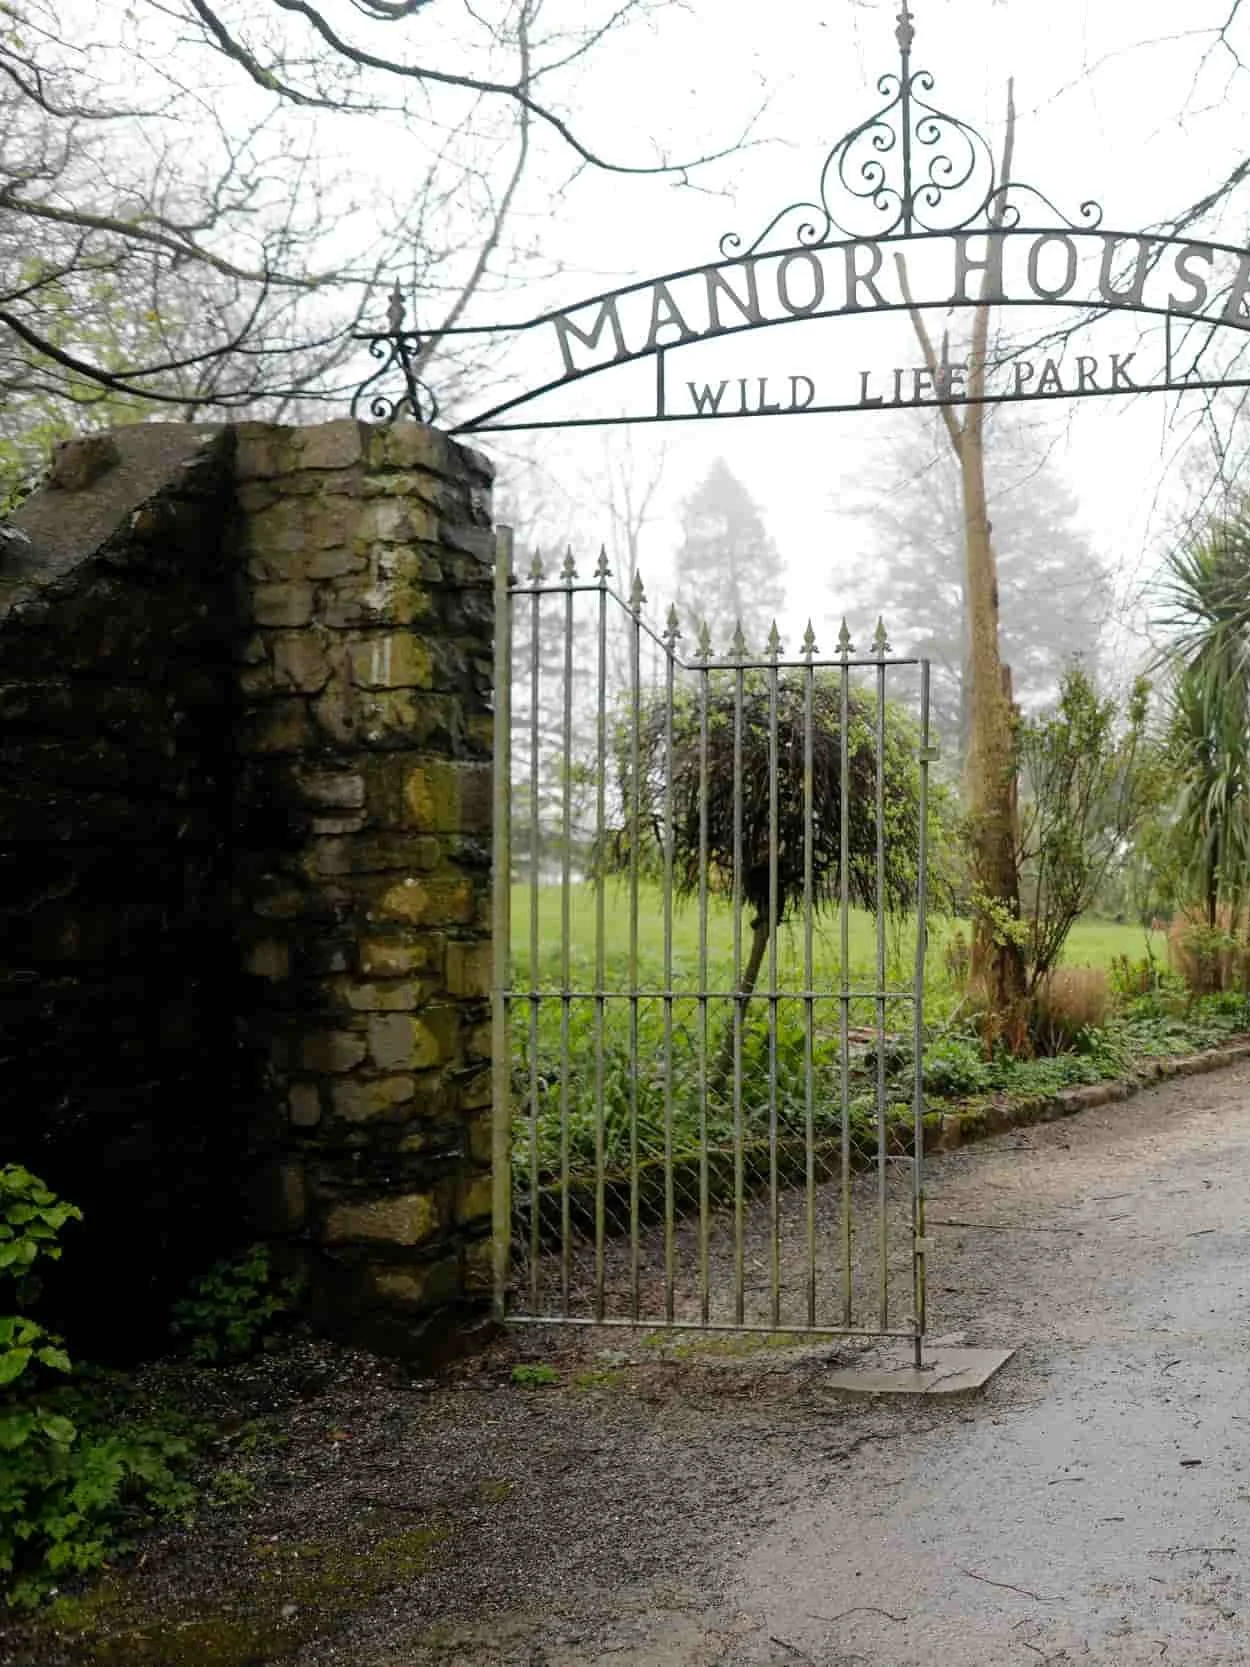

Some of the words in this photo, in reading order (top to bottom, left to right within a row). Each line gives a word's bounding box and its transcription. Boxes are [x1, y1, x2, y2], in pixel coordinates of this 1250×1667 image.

[553, 241, 890, 379] MANOR
[685, 376, 815, 414] WILD
[859, 363, 968, 405] LIFE
[1012, 352, 1136, 397] PARK
